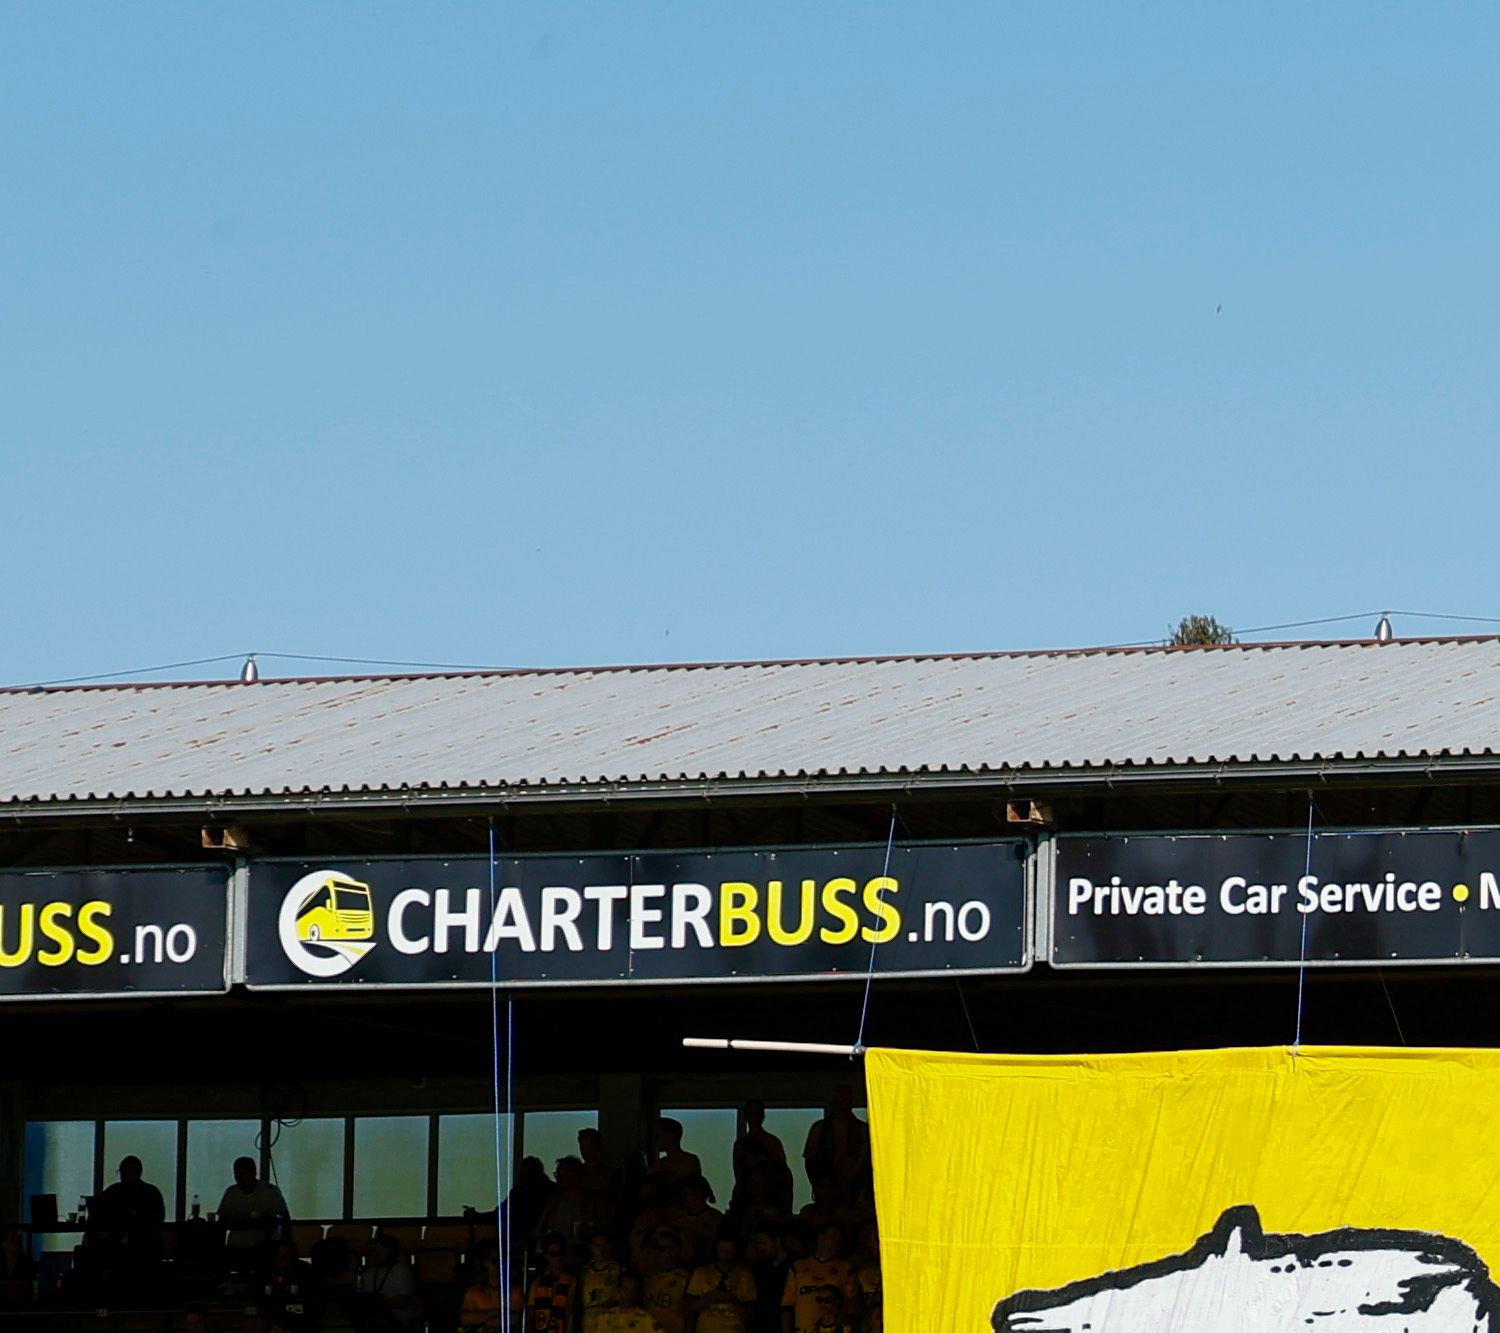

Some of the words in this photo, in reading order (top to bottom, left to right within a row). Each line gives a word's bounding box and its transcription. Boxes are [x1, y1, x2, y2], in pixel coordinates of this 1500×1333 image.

[387, 877, 991, 955] CHARTERBUSS.no
[1069, 876, 1206, 915] Private
[1220, 876, 1287, 915] Car
[1296, 873, 1442, 914] Service
